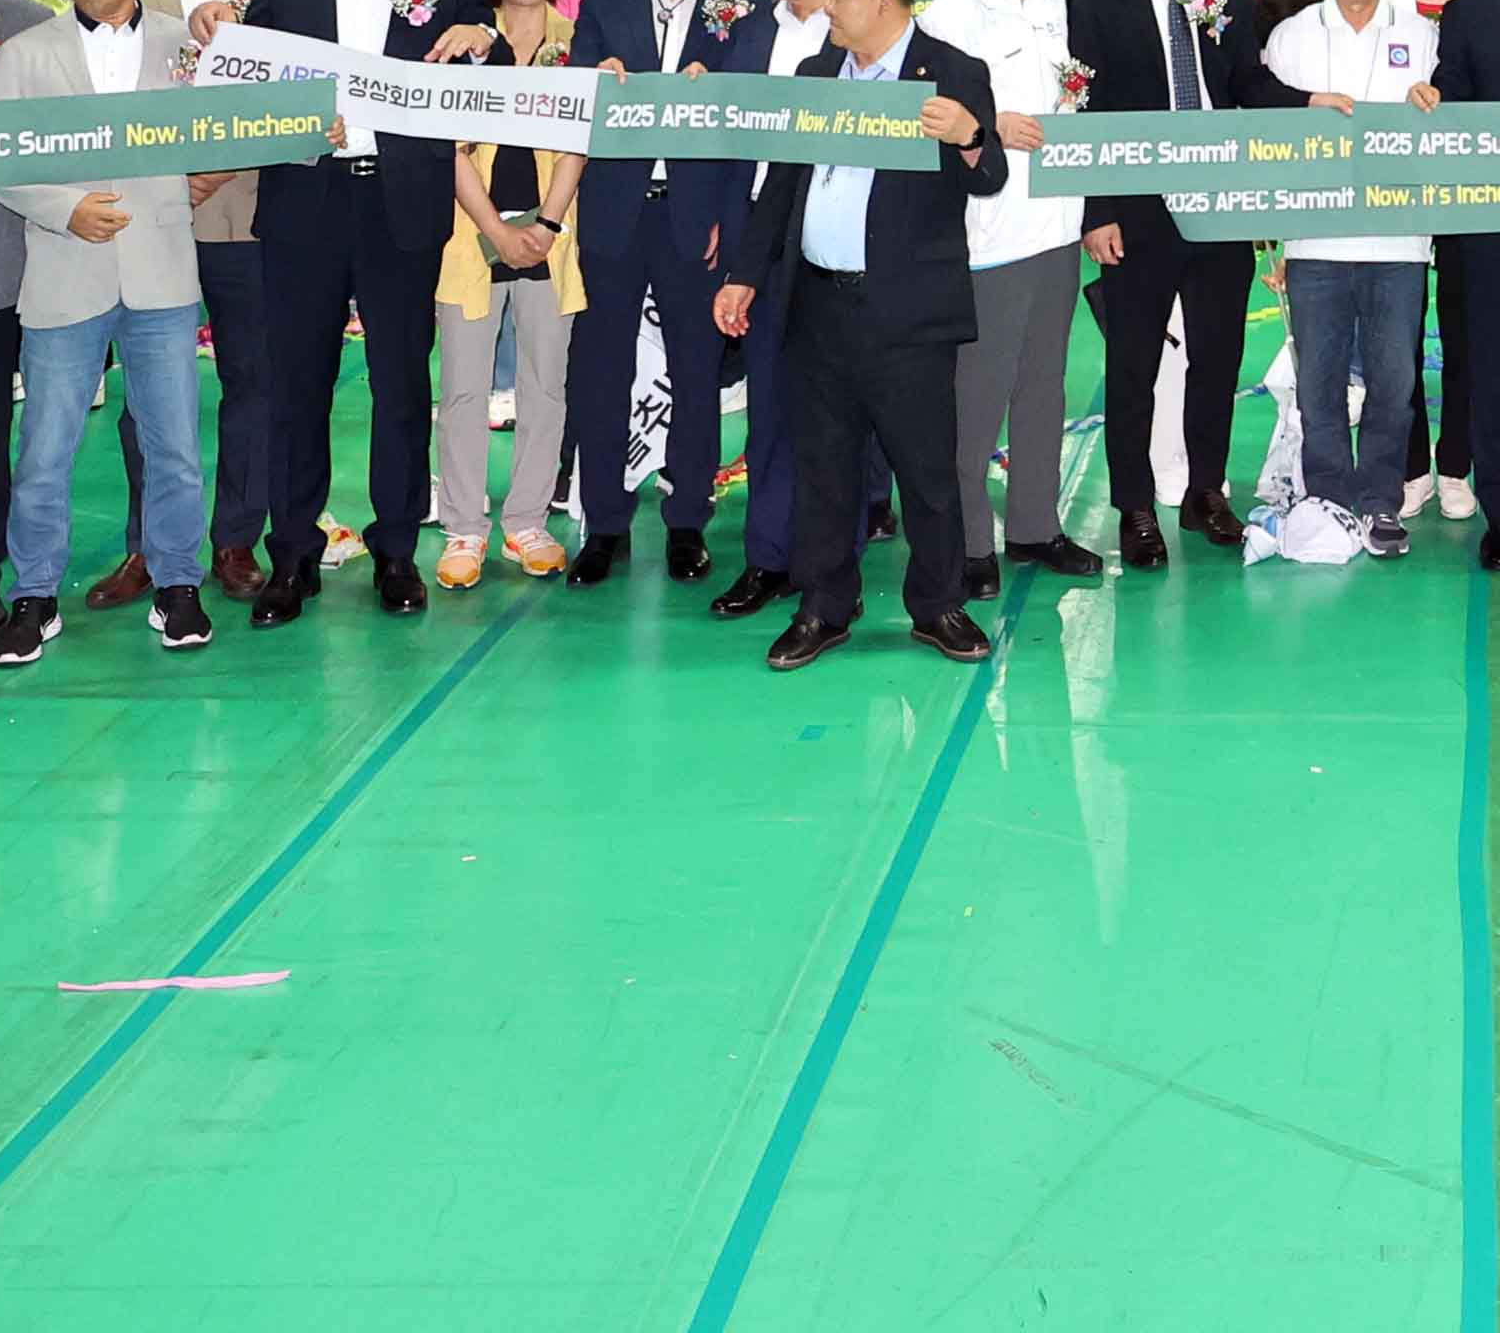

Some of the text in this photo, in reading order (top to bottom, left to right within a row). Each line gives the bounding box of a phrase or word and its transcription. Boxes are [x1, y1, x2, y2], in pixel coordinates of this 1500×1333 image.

[210, 55, 506, 113] 2025 정상회의 이제는
[18, 125, 113, 157] Summit
[191, 116, 227, 142] it's
[231, 114, 322, 140] Incheon
[606, 105, 655, 128] 2025
[660, 105, 719, 128] APEC
[725, 105, 793, 132] Summit
[832, 111, 855, 135] it's
[858, 113, 924, 138] Incheon
[1041, 143, 1093, 167] 2025
[1098, 141, 1153, 165] APEC
[1157, 139, 1239, 165] Summit
[1305, 135, 1334, 160] it's
[1364, 132, 1414, 156] 2025
[1418, 132, 1472, 156] APEC
[1214, 188, 1270, 213] APEC
[1274, 185, 1355, 211] Summit
[1422, 182, 1452, 206] it's
